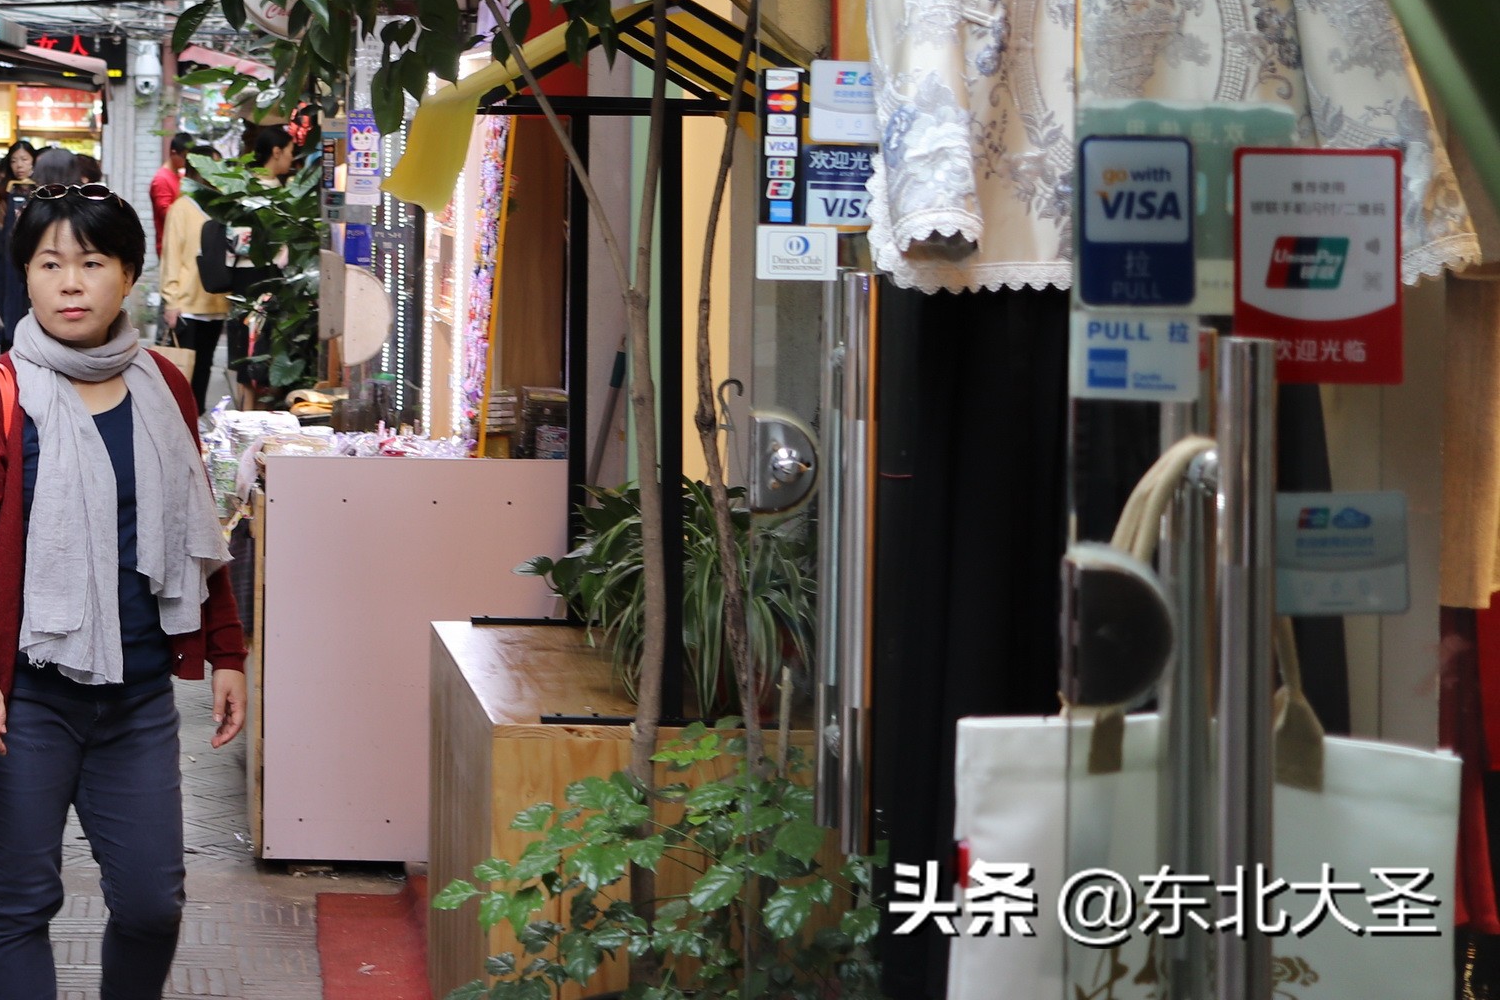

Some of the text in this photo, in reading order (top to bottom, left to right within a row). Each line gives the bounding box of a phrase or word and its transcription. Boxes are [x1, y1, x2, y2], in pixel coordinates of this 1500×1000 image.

[768, 142, 796, 152] VISA
[808, 150, 874, 171] 欢迎光
[1102, 166, 1172, 186] go with
[1096, 190, 1182, 220] VISA
[772, 255, 822, 265] Diners Club
[1273, 248, 1342, 268] UnionPay
[1111, 281, 1163, 300] PULL
[1087, 320, 1151, 341] PULL
[1168, 321, 1190, 343] 拉
